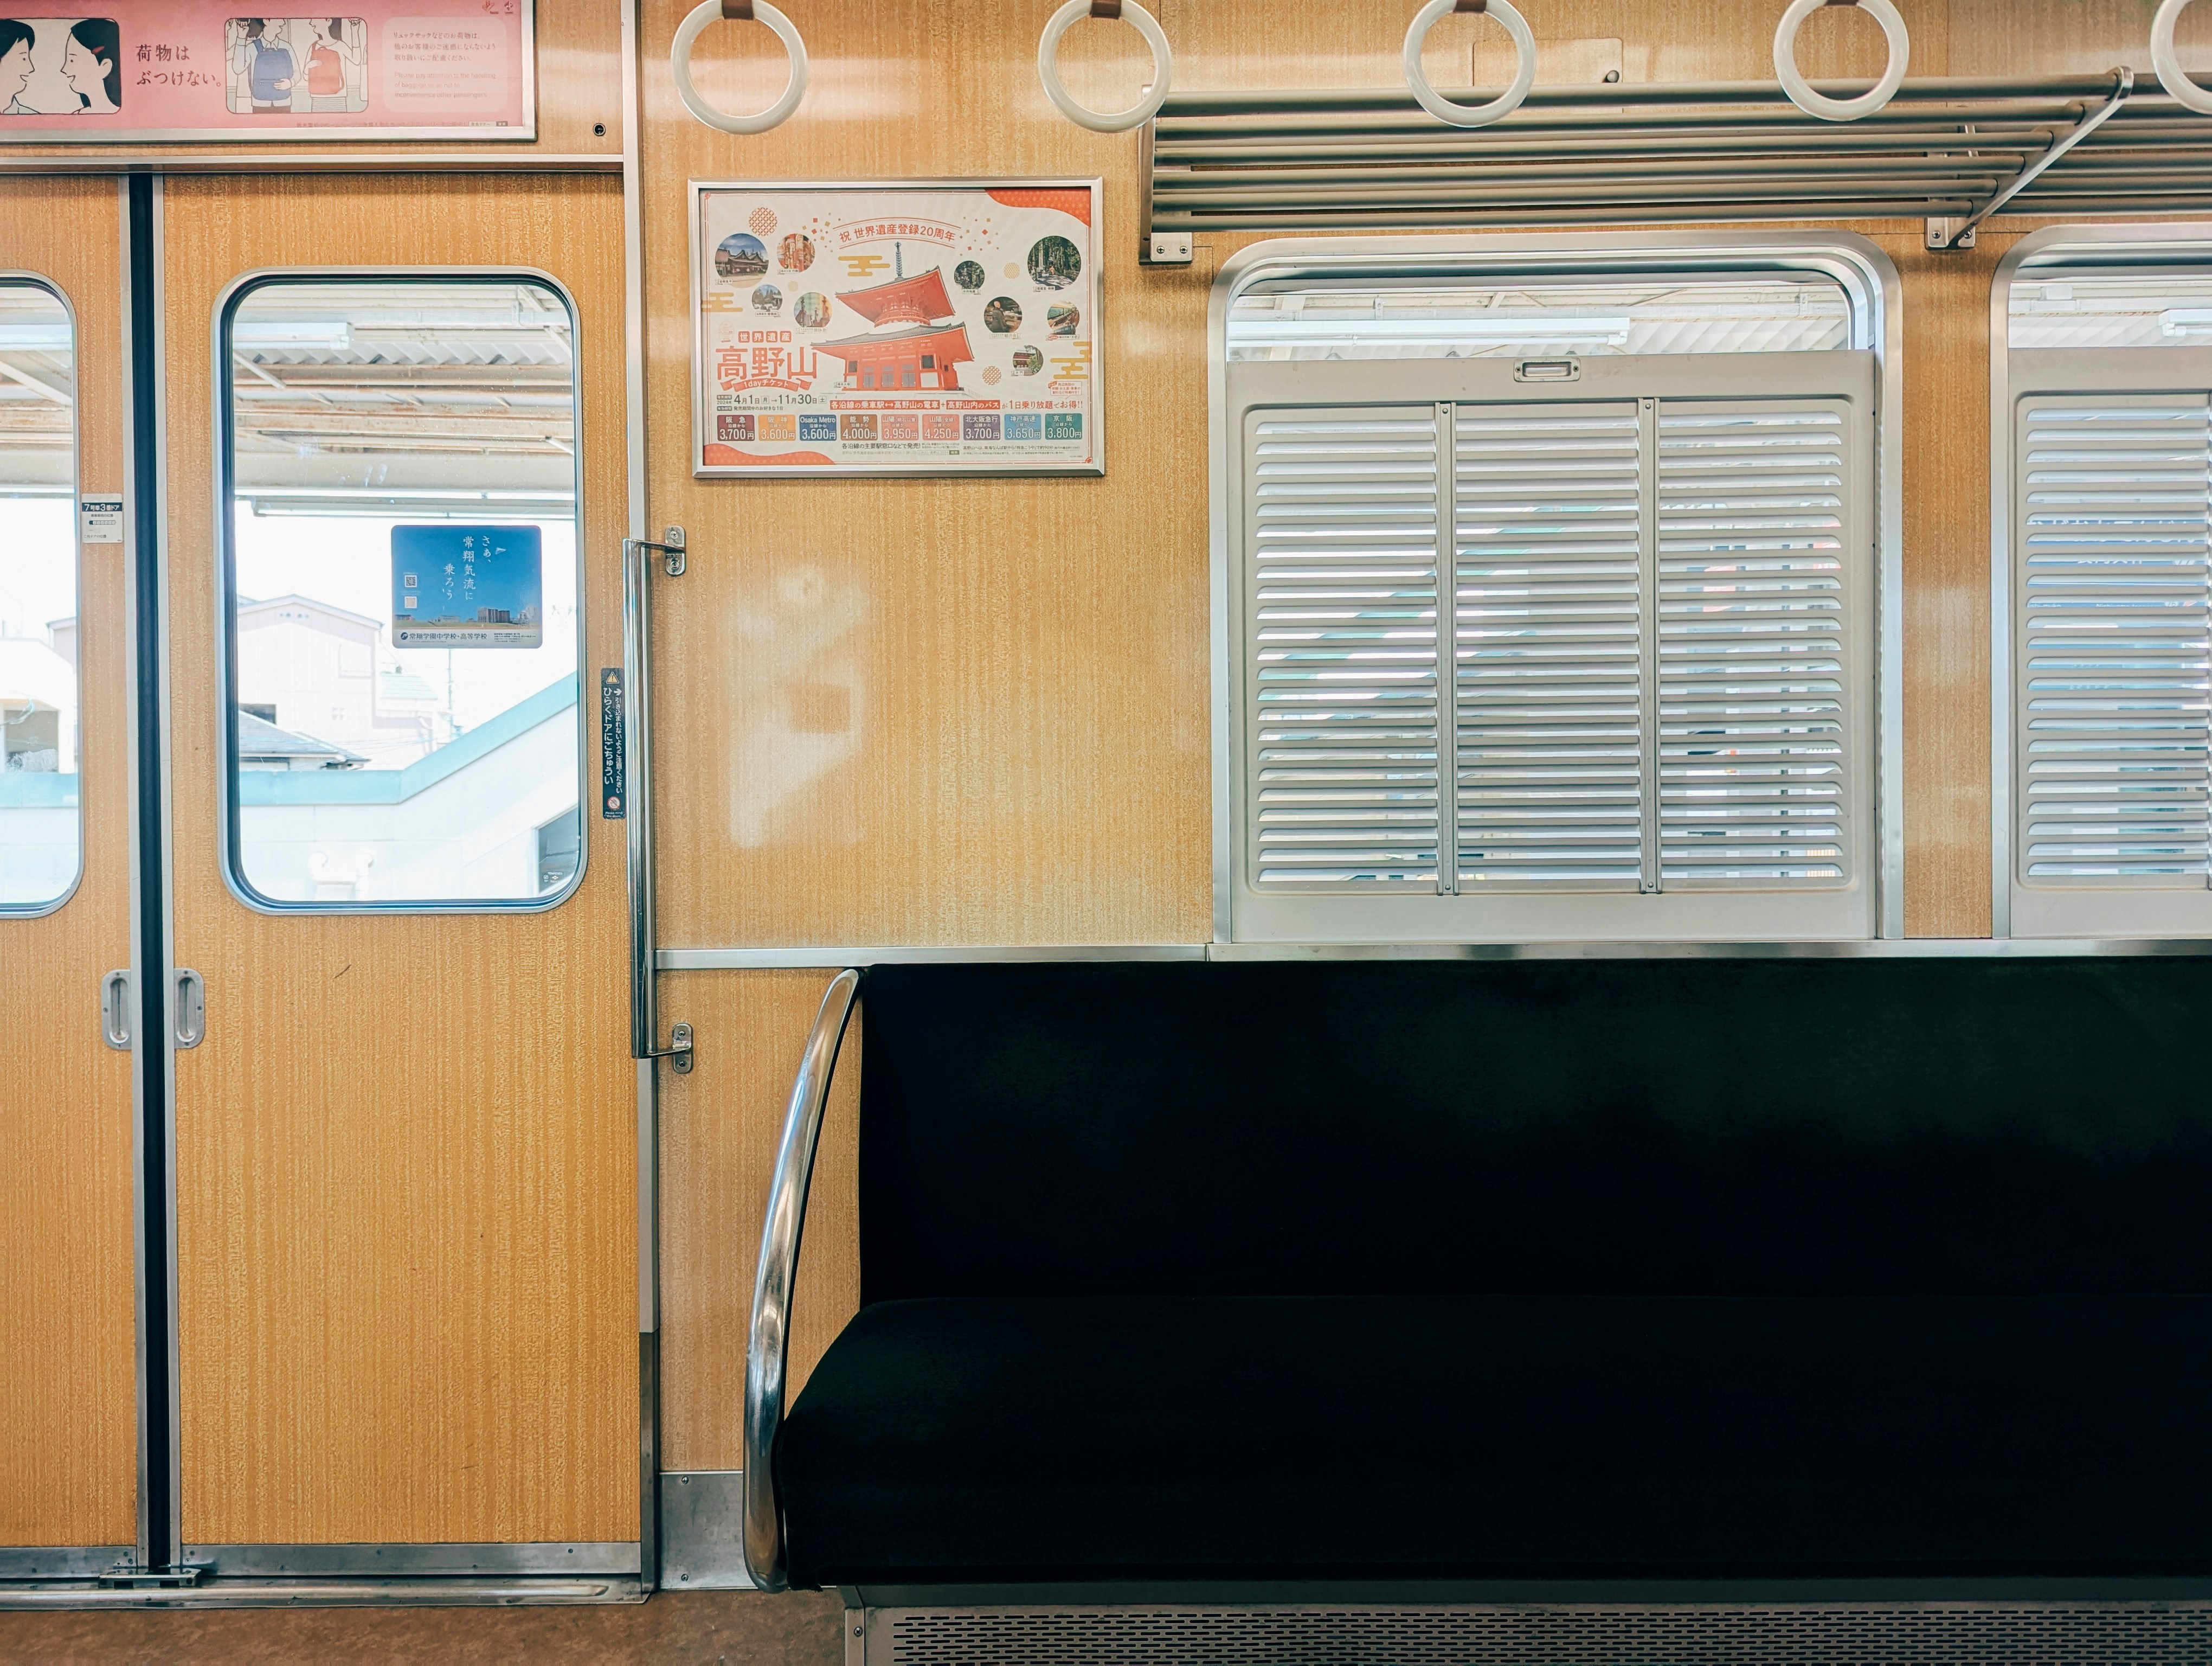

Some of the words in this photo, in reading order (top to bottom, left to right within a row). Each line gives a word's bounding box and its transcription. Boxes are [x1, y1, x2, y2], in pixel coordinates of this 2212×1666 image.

[136, 44, 190, 62] 荷物は
[137, 71, 221, 87] ぶつけない。
[839, 230, 851, 243] 祝
[854, 223, 956, 242] 世界遺産登録20周年
[740, 332, 790, 342] 世界遺産
[716, 346, 817, 380] 高野山
[744, 379, 788, 388] 1dayチケット
[719, 428, 754, 440] 3,700円
[761, 428, 795, 440] 3,600円
[802, 428, 836, 440] 3,600円
[843, 428, 877, 439] 4,000円
[884, 428, 918, 439] 3,950円
[925, 428, 959, 439] 4,250円
[966, 428, 1000, 439] 3,700円
[1007, 428, 1040, 439] 3,650円
[1047, 427, 1082, 439] 3,800円
[481, 536, 491, 562] さあ、
[462, 536, 476, 600] 常翔気流に
[443, 563, 455, 600] 乗ろう
[603, 687, 614, 785] ひらくドアにごちゅうい
